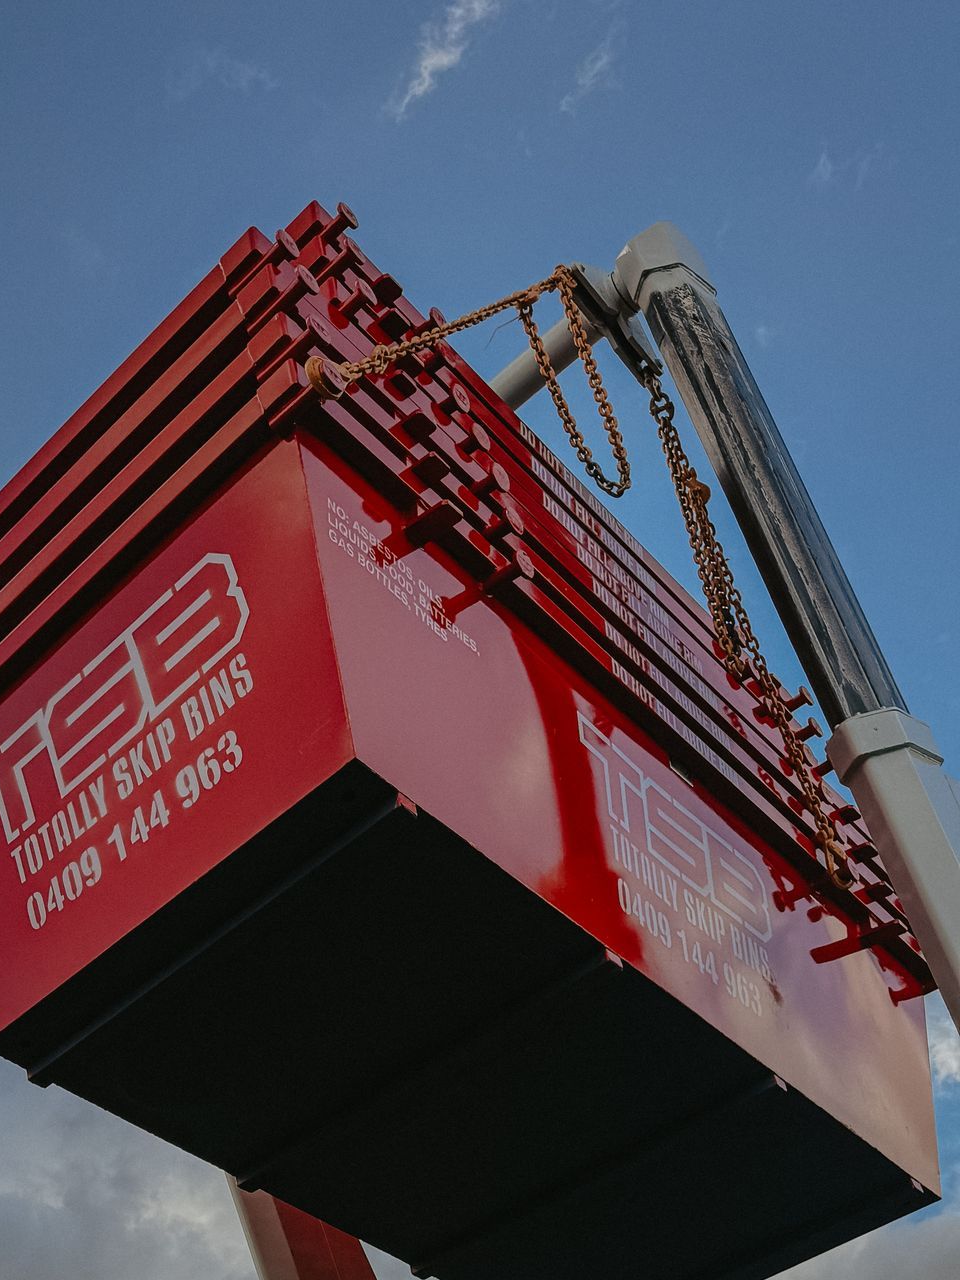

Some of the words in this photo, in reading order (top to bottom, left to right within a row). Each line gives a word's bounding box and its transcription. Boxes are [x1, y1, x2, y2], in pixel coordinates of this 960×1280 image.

[327, 497, 349, 524] NO:
[353, 521, 416, 585] ASBESTOS,
[418, 579, 445, 613] OILS,
[328, 529, 354, 557] GAS
[358, 555, 411, 610] BOTTLES,
[414, 603, 448, 642] TYRES
[419, 594, 480, 656] BATTERIES,
[10, 773, 111, 884] TOTALLY
[111, 716, 176, 800] SKIP
[180, 653, 254, 741] BINS
[25, 846, 102, 930] 0409
[107, 790, 170, 863] 144
[175, 730, 244, 808] 963
[577, 710, 773, 944] TSB
[610, 823, 678, 913] TOTALLY
[683, 888, 726, 945] SKIP
[730, 923, 777, 985] BINS
[617, 878, 672, 949] 0409
[676, 929, 719, 985] 144
[723, 962, 763, 1017] 963
